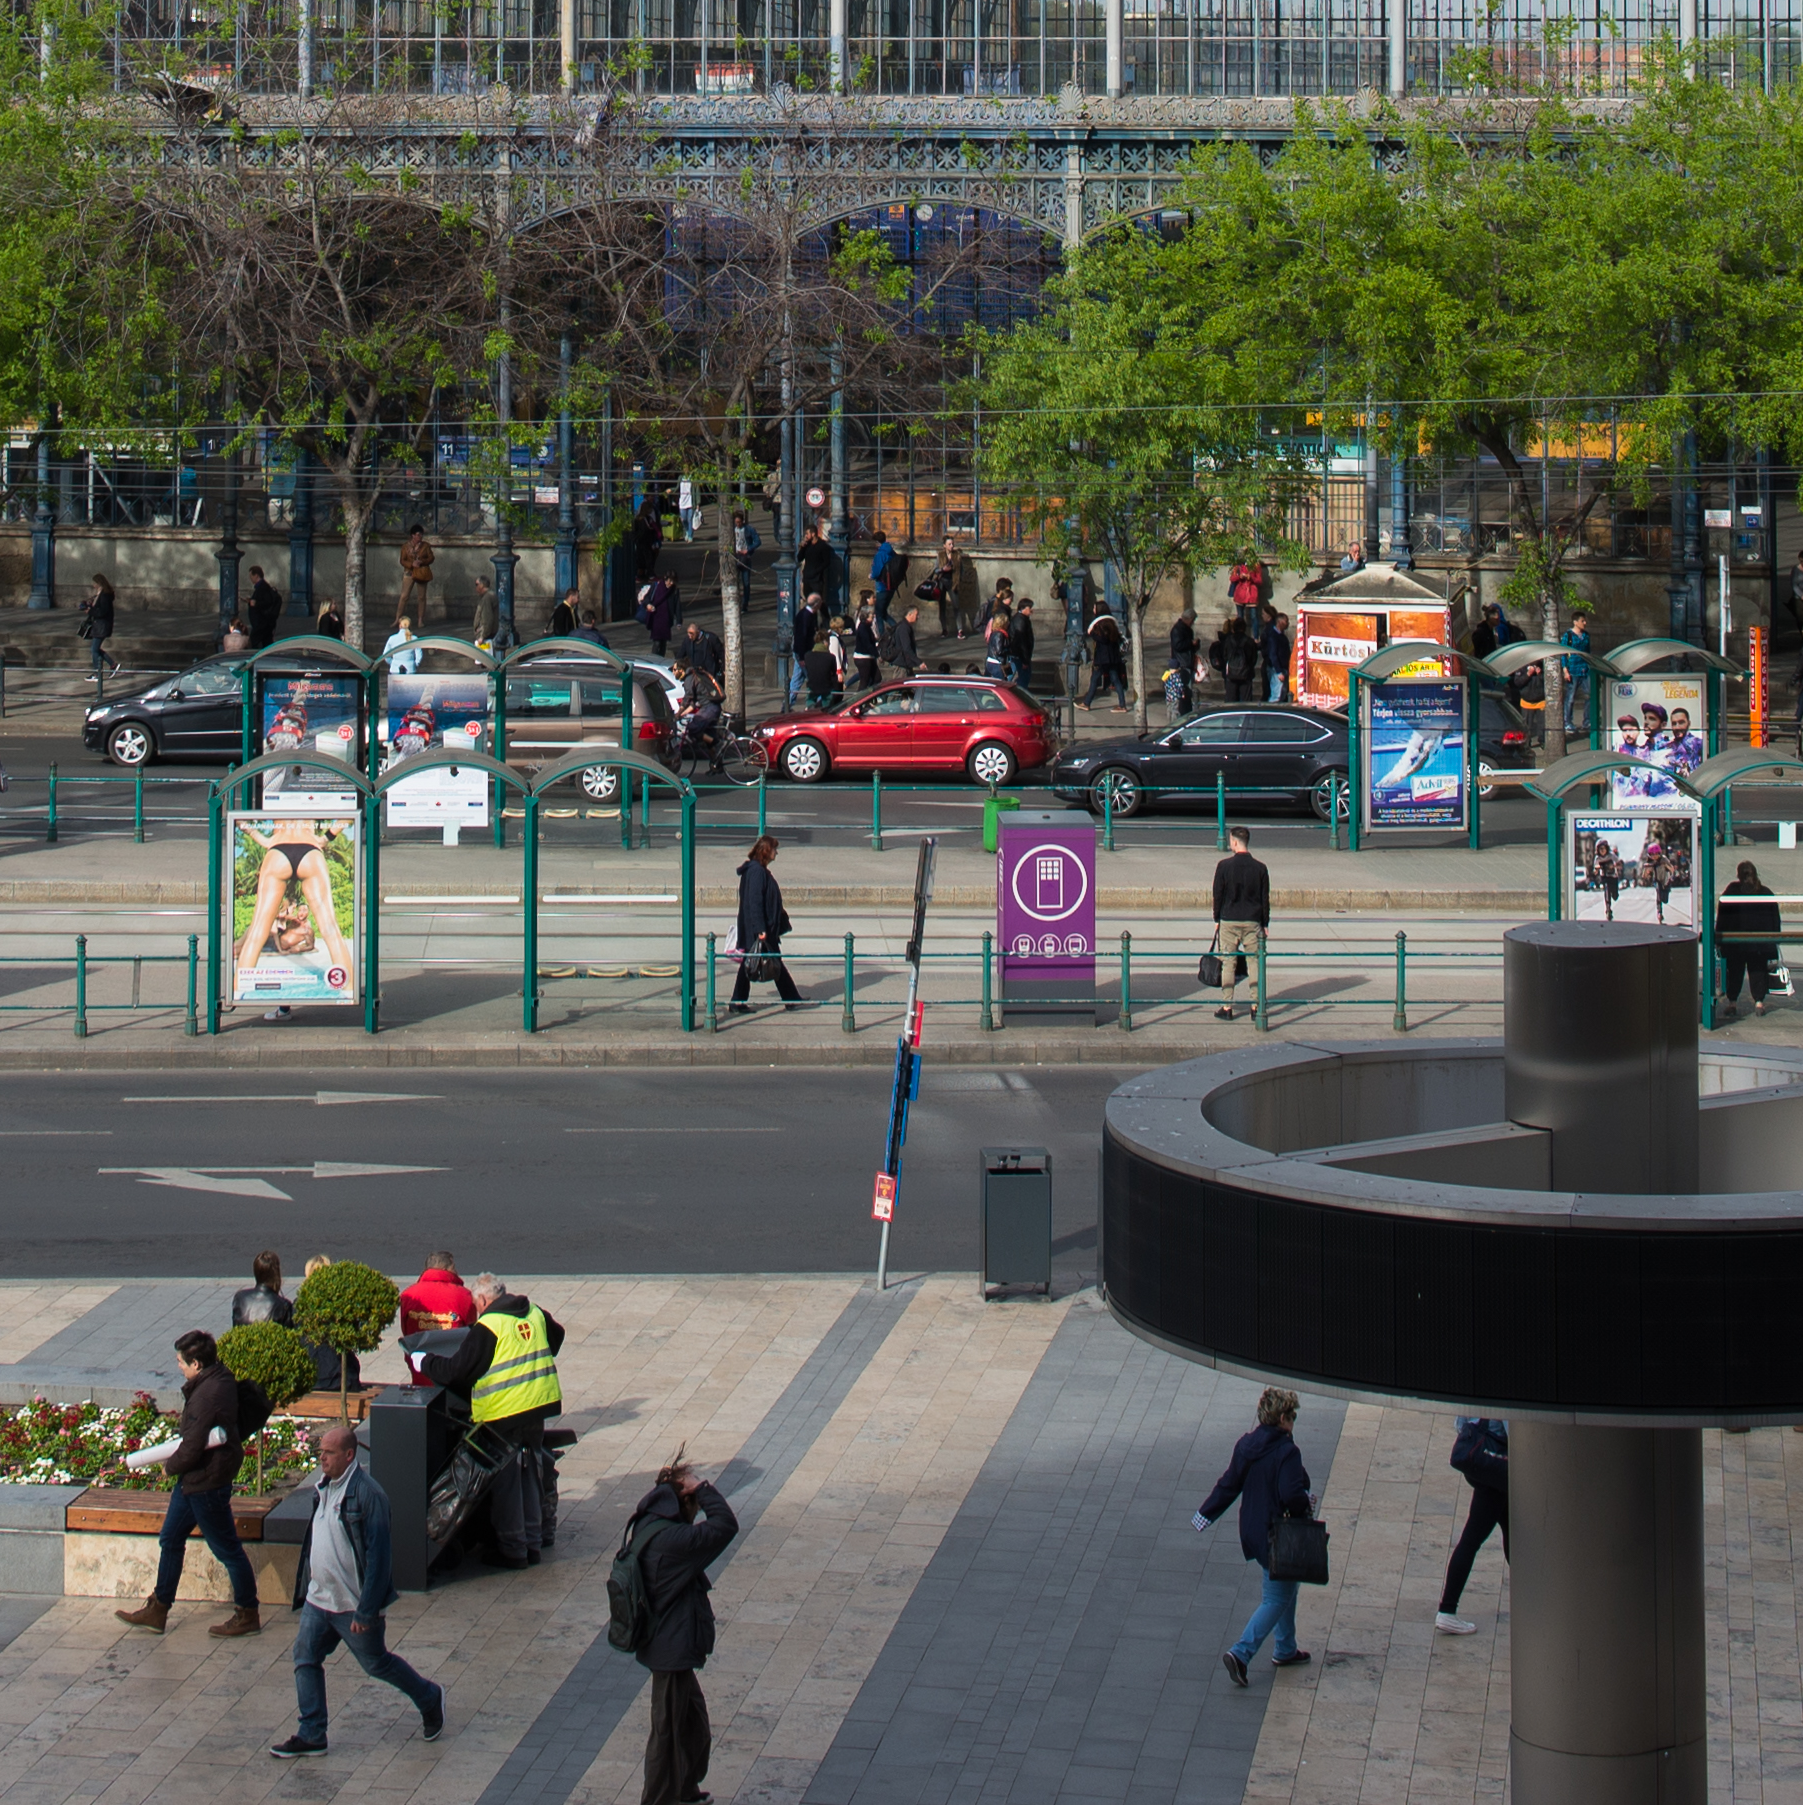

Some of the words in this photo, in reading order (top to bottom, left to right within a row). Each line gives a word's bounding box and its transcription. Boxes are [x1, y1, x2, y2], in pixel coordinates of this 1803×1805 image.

[441, 444, 454, 455] 11
[1417, 778, 1443, 790] Advil
[1576, 819, 1630, 829] DECATHLON
